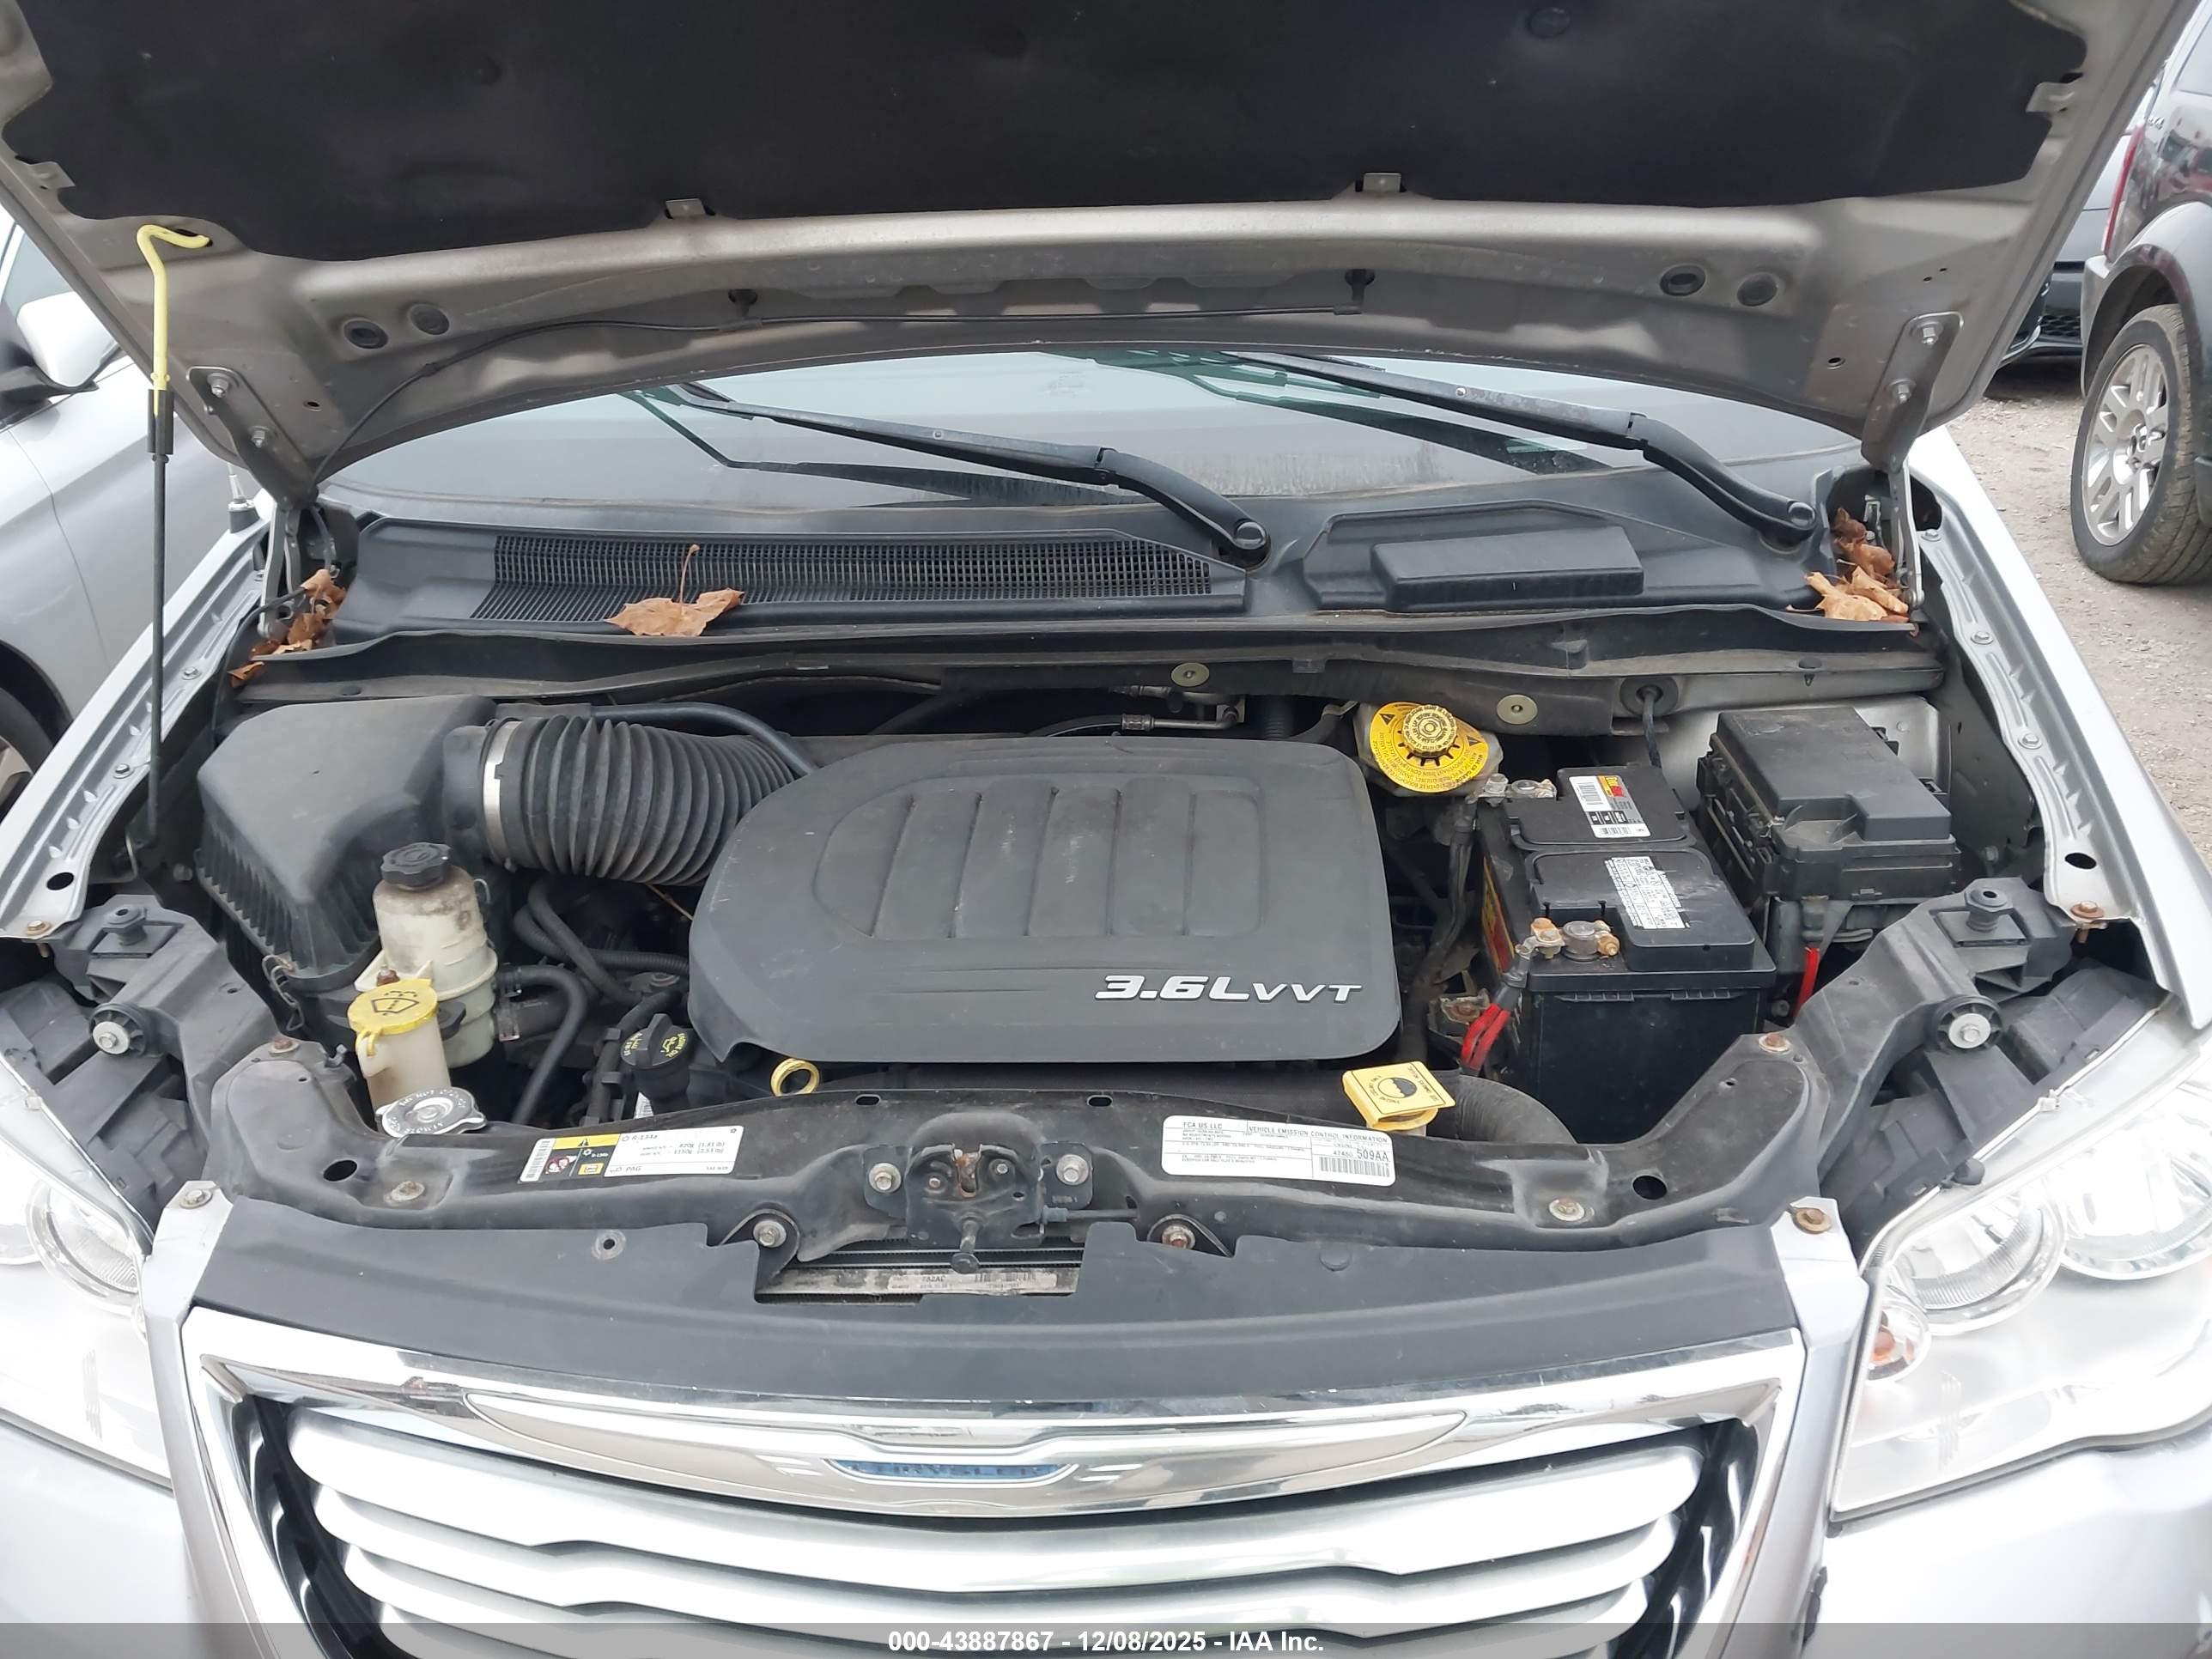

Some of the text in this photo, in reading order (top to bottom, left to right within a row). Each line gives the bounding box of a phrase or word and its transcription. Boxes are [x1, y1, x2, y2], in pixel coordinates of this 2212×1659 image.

[1278, 1127, 1309, 1136] EMISSION
[1342, 1133, 1388, 1143] INFORMATION
[1356, 1148, 1389, 1162] 509AA
